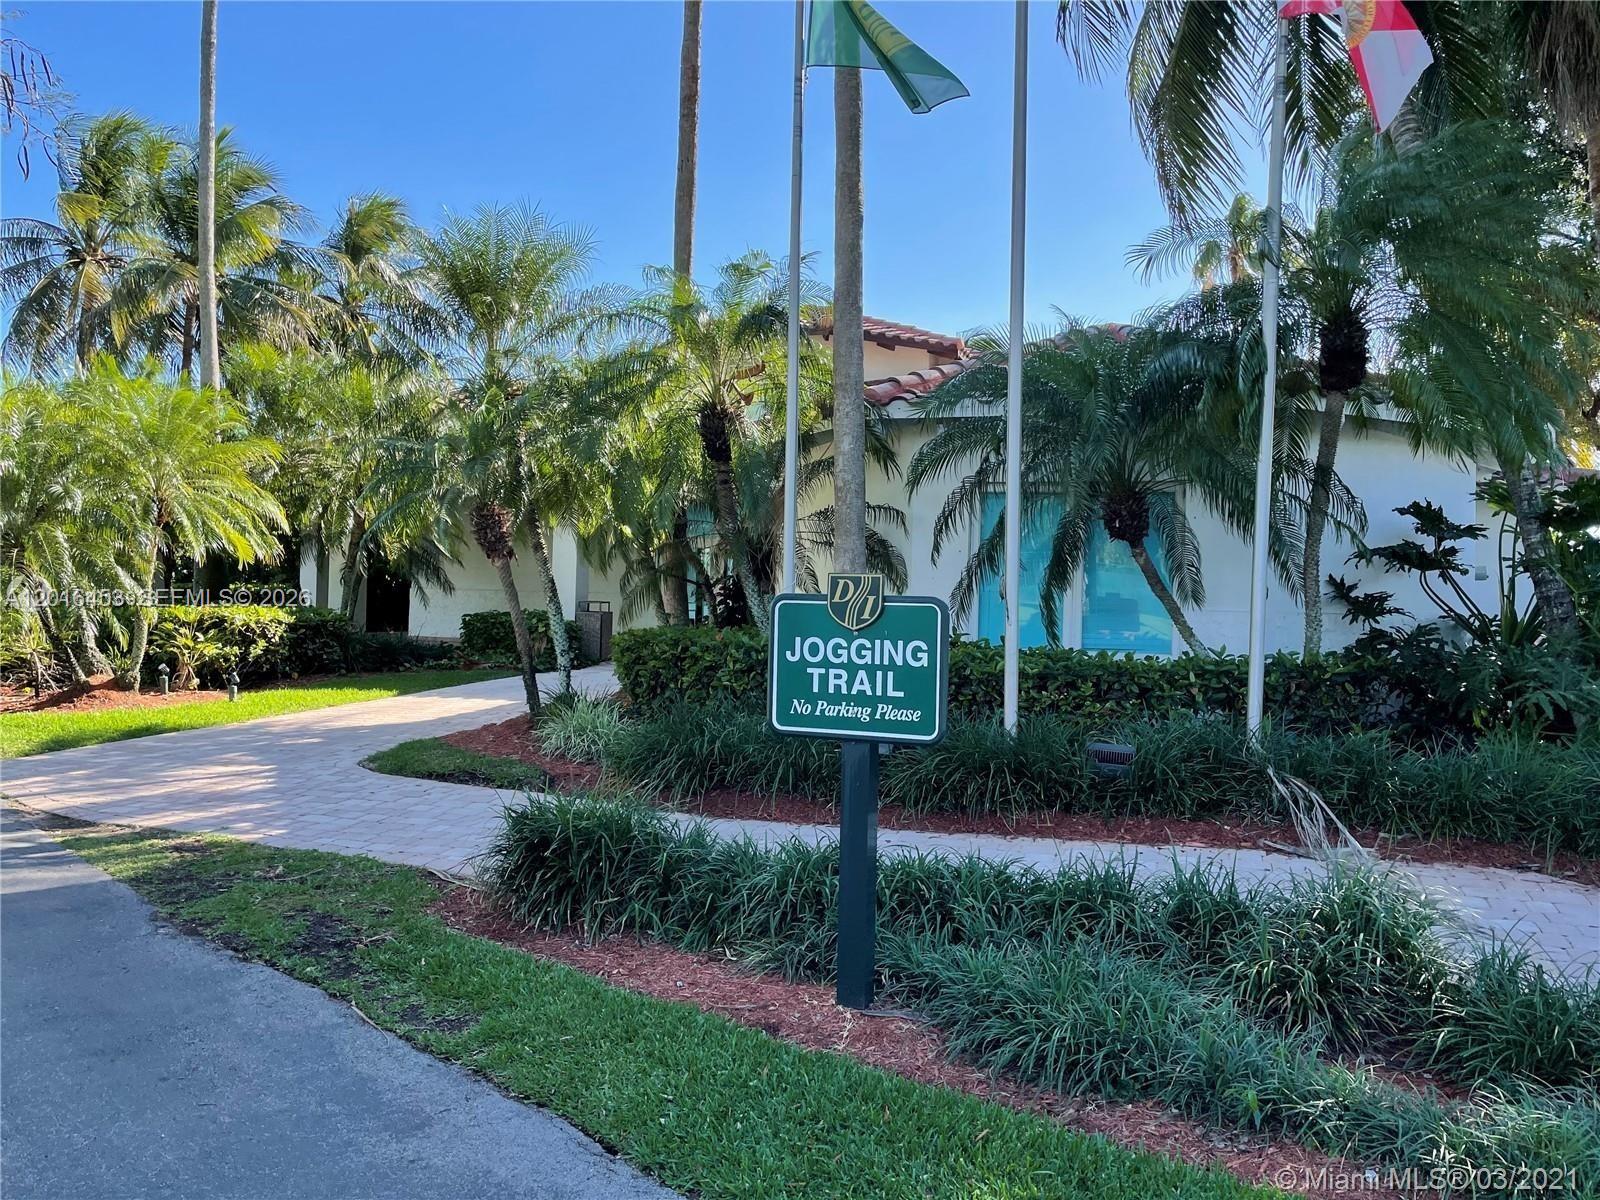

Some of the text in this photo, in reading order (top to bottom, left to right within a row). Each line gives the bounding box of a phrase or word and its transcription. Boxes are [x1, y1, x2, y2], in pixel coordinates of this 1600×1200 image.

[786, 636, 928, 667] JOGGING
[807, 668, 904, 697] TRAIL
[790, 699, 921, 722] No Parking Please
